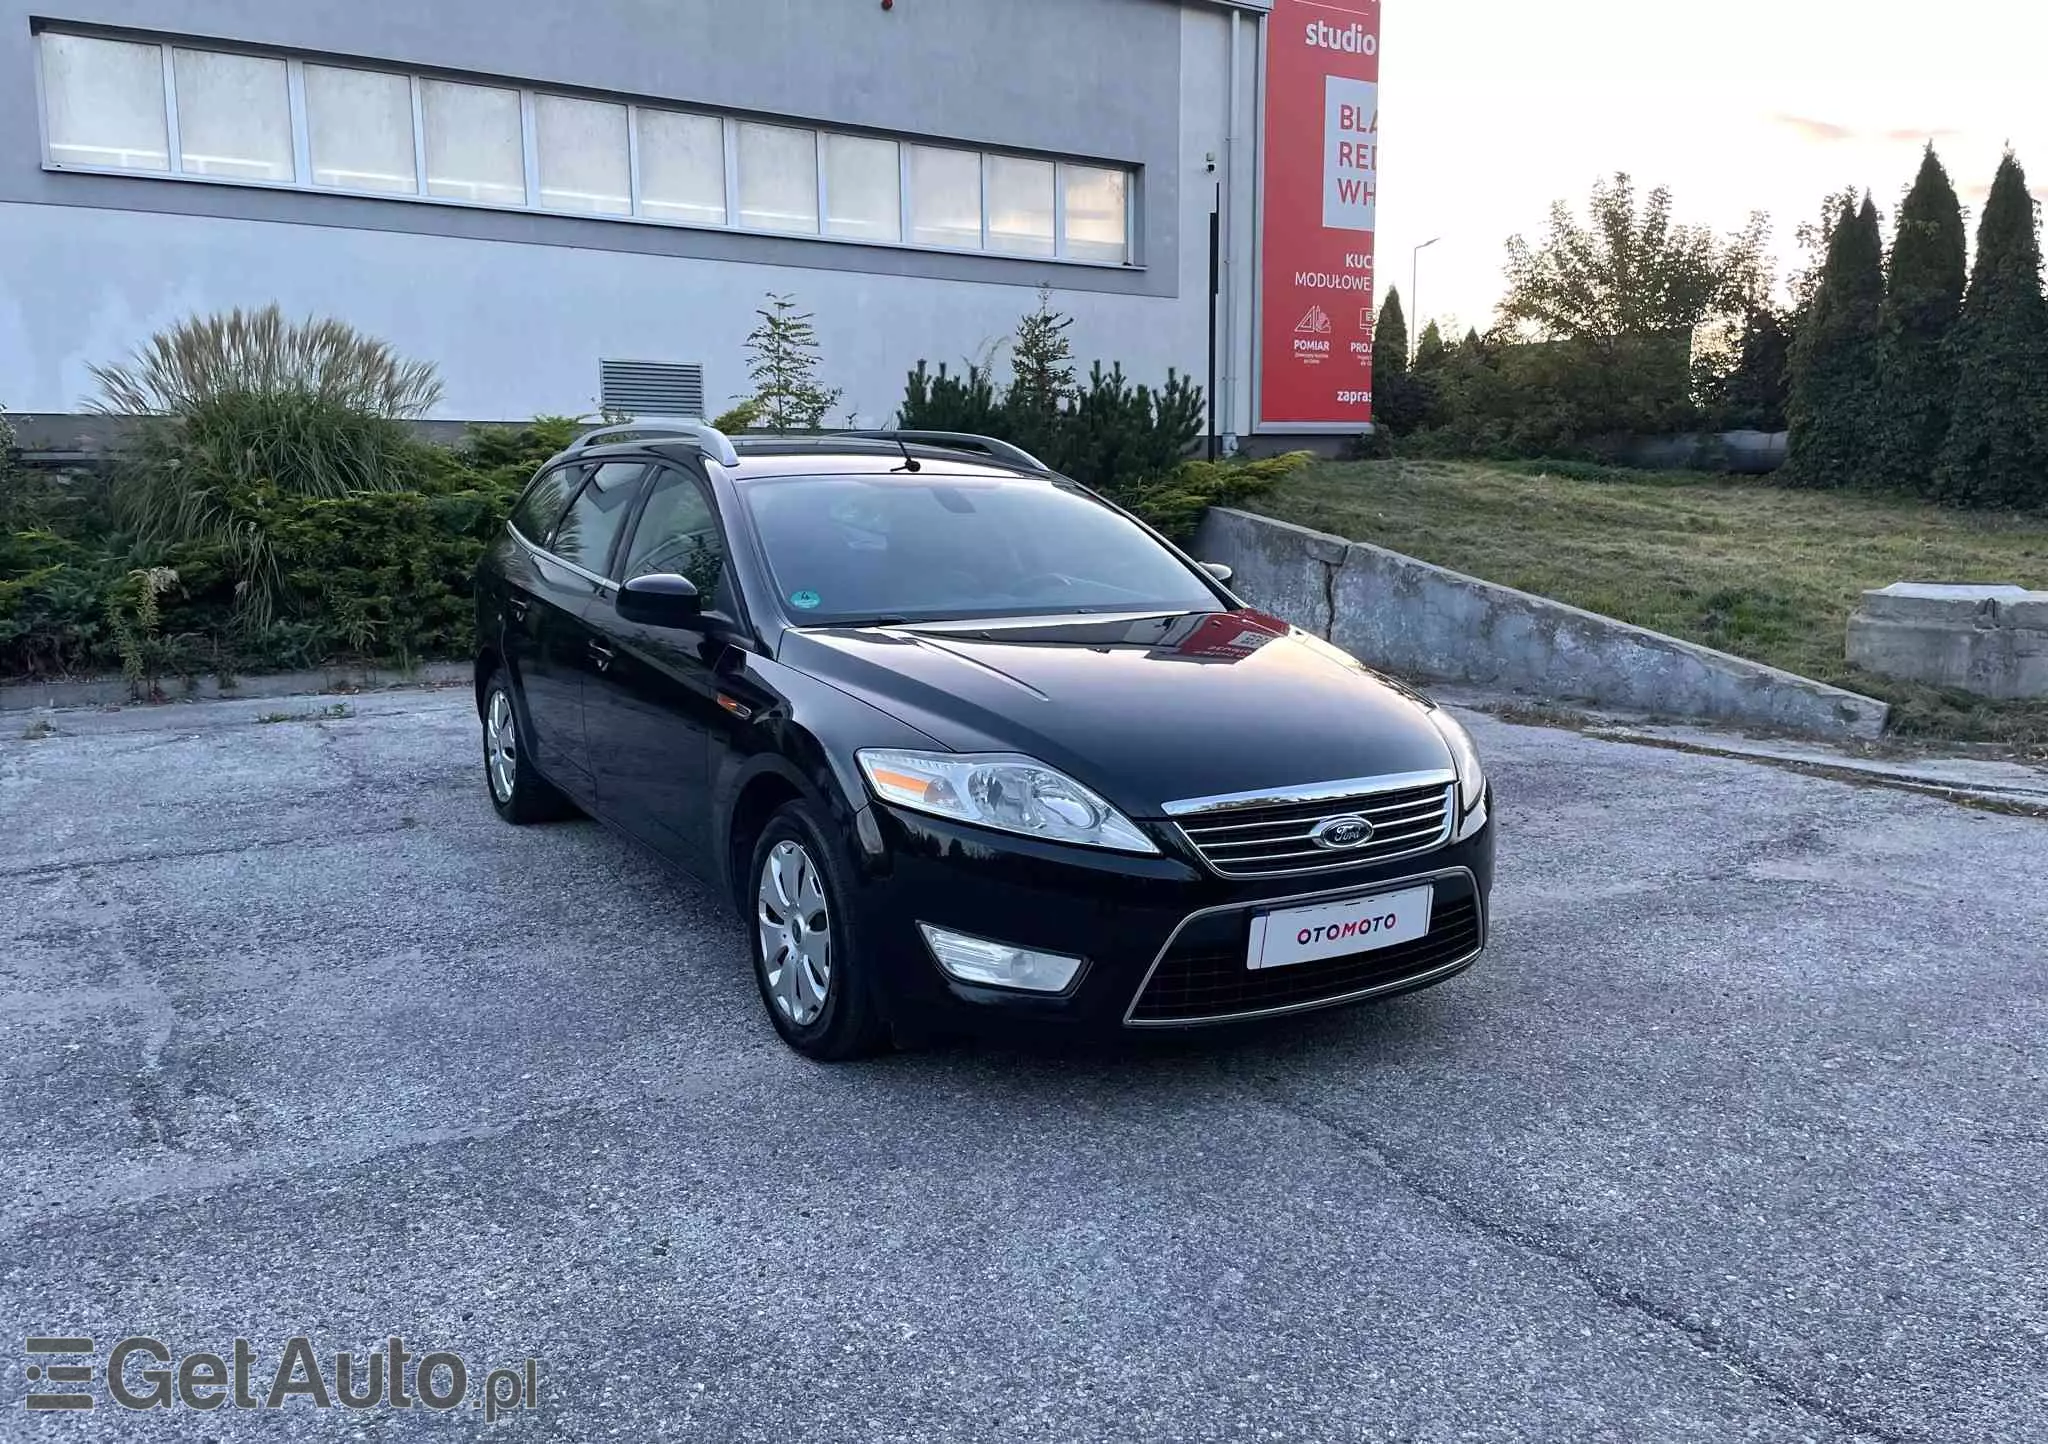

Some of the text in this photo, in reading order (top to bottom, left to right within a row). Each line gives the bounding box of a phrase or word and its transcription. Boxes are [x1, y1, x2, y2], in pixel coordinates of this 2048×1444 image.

[1305, 19, 1377, 55] studio
[1295, 271, 1371, 292] MODUŁOWE
[1294, 339, 1330, 352] POMIAR
[1334, 825, 1361, 842] Ford
[1297, 912, 1397, 945] OTOMOTO
